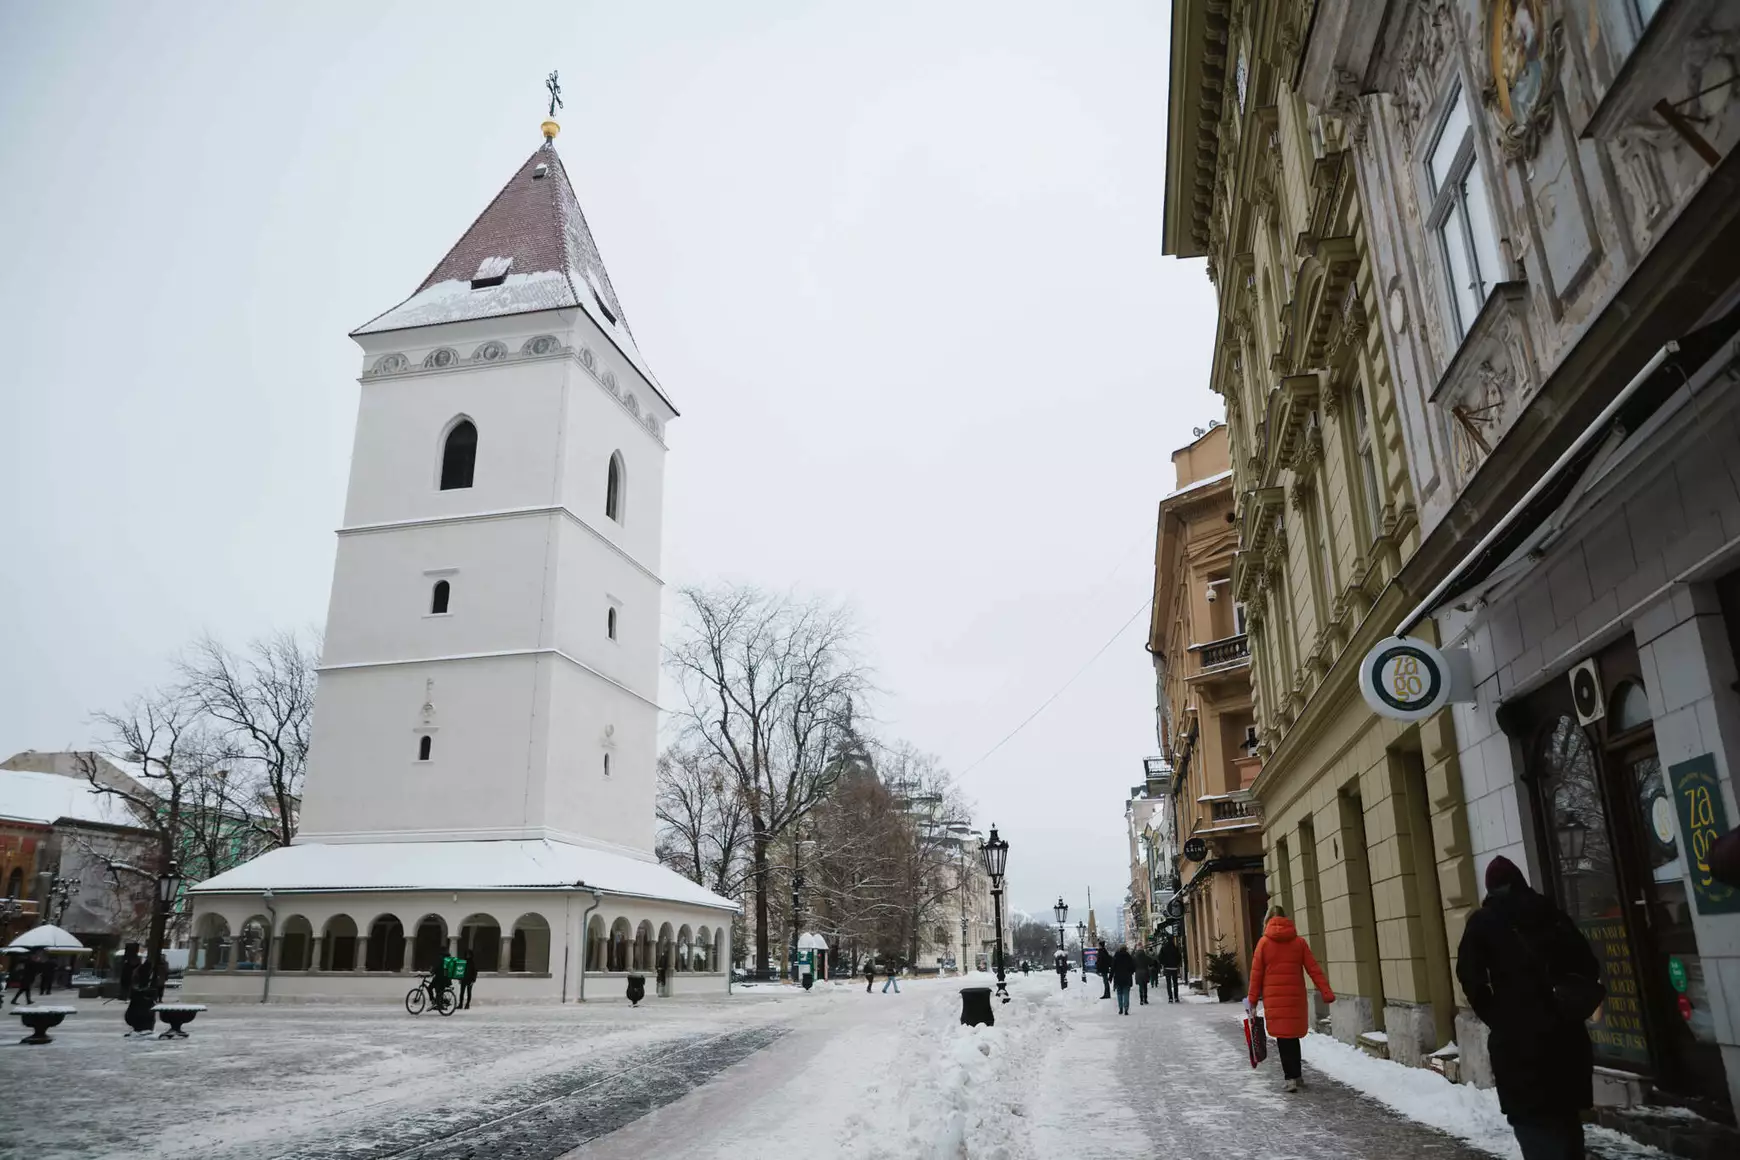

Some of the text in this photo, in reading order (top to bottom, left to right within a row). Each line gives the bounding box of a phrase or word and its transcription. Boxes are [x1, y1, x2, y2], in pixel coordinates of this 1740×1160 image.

[1392, 655, 1419, 676] za
[1393, 673, 1422, 702] go
[1684, 785, 1715, 829] za
